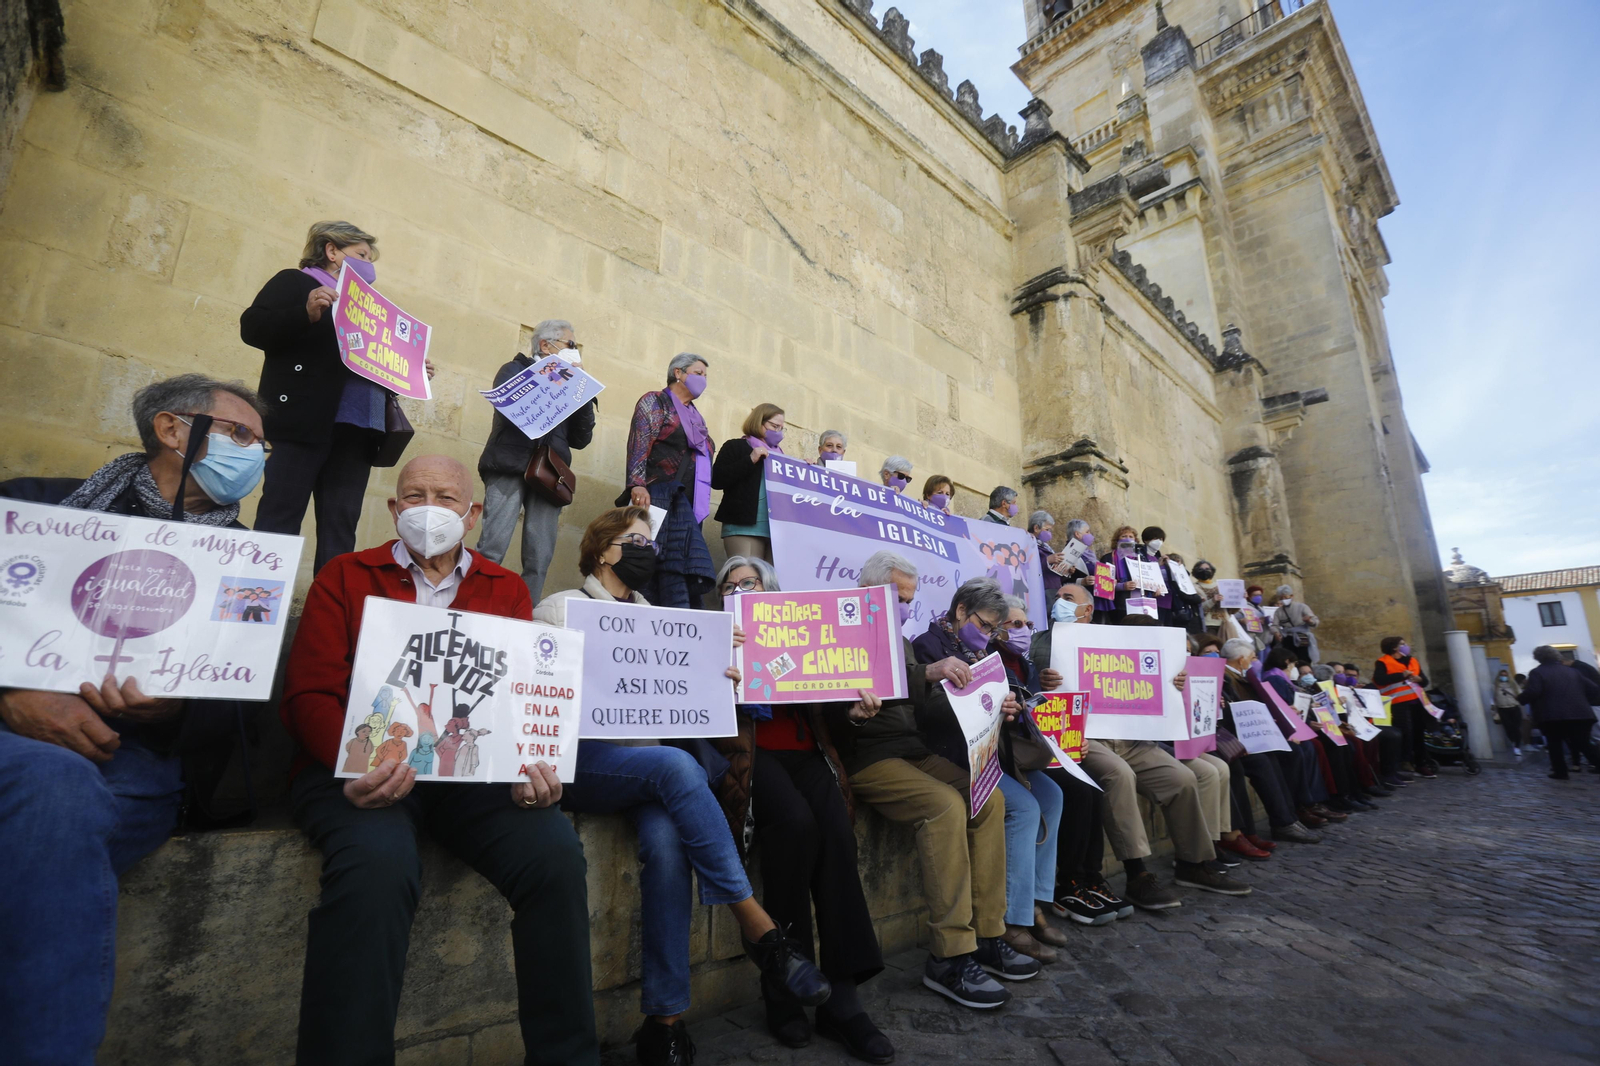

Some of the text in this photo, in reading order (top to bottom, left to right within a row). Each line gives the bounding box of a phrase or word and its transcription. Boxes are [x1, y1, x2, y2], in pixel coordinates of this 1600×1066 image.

[348, 280, 387, 323] NOSOTRAS
[345, 300, 377, 336] SOMOS
[382, 327, 392, 346] EL
[366, 342, 409, 377] CAMBIO
[510, 383, 535, 401] IGLESIA
[531, 394, 541, 405] que
[540, 386, 550, 394] la
[771, 459, 946, 527] REVUELTA DE MUJERES
[792, 493, 863, 518] en la
[5, 510, 284, 571] Revuelta de mujeres
[877, 521, 949, 557] IGLESIA
[146, 566, 164, 575] que
[106, 603, 127, 614] haga
[752, 600, 822, 624] NOSOTRAS
[599, 615, 702, 641] CON VOTO,
[754, 624, 837, 648] SOMOS EL
[25, 630, 257, 692] la Iglesia
[400, 628, 508, 678] ALCEMOS
[612, 646, 690, 667] CON VOZ
[802, 647, 869, 674] CAMBIO
[1083, 652, 1135, 674] DIGNIDAD
[384, 657, 502, 697] LA VOZ
[614, 677, 688, 695] ASI NOS
[794, 681, 849, 690] CÓRDOBA
[1094, 674, 1154, 701] E IGUALDAD
[510, 682, 575, 700] IGUALDAD
[524, 703, 560, 718] EN LA
[591, 707, 710, 726] QUIERE DIOS
[522, 723, 560, 737] CALLE
[516, 742, 562, 757] Y EN EL
